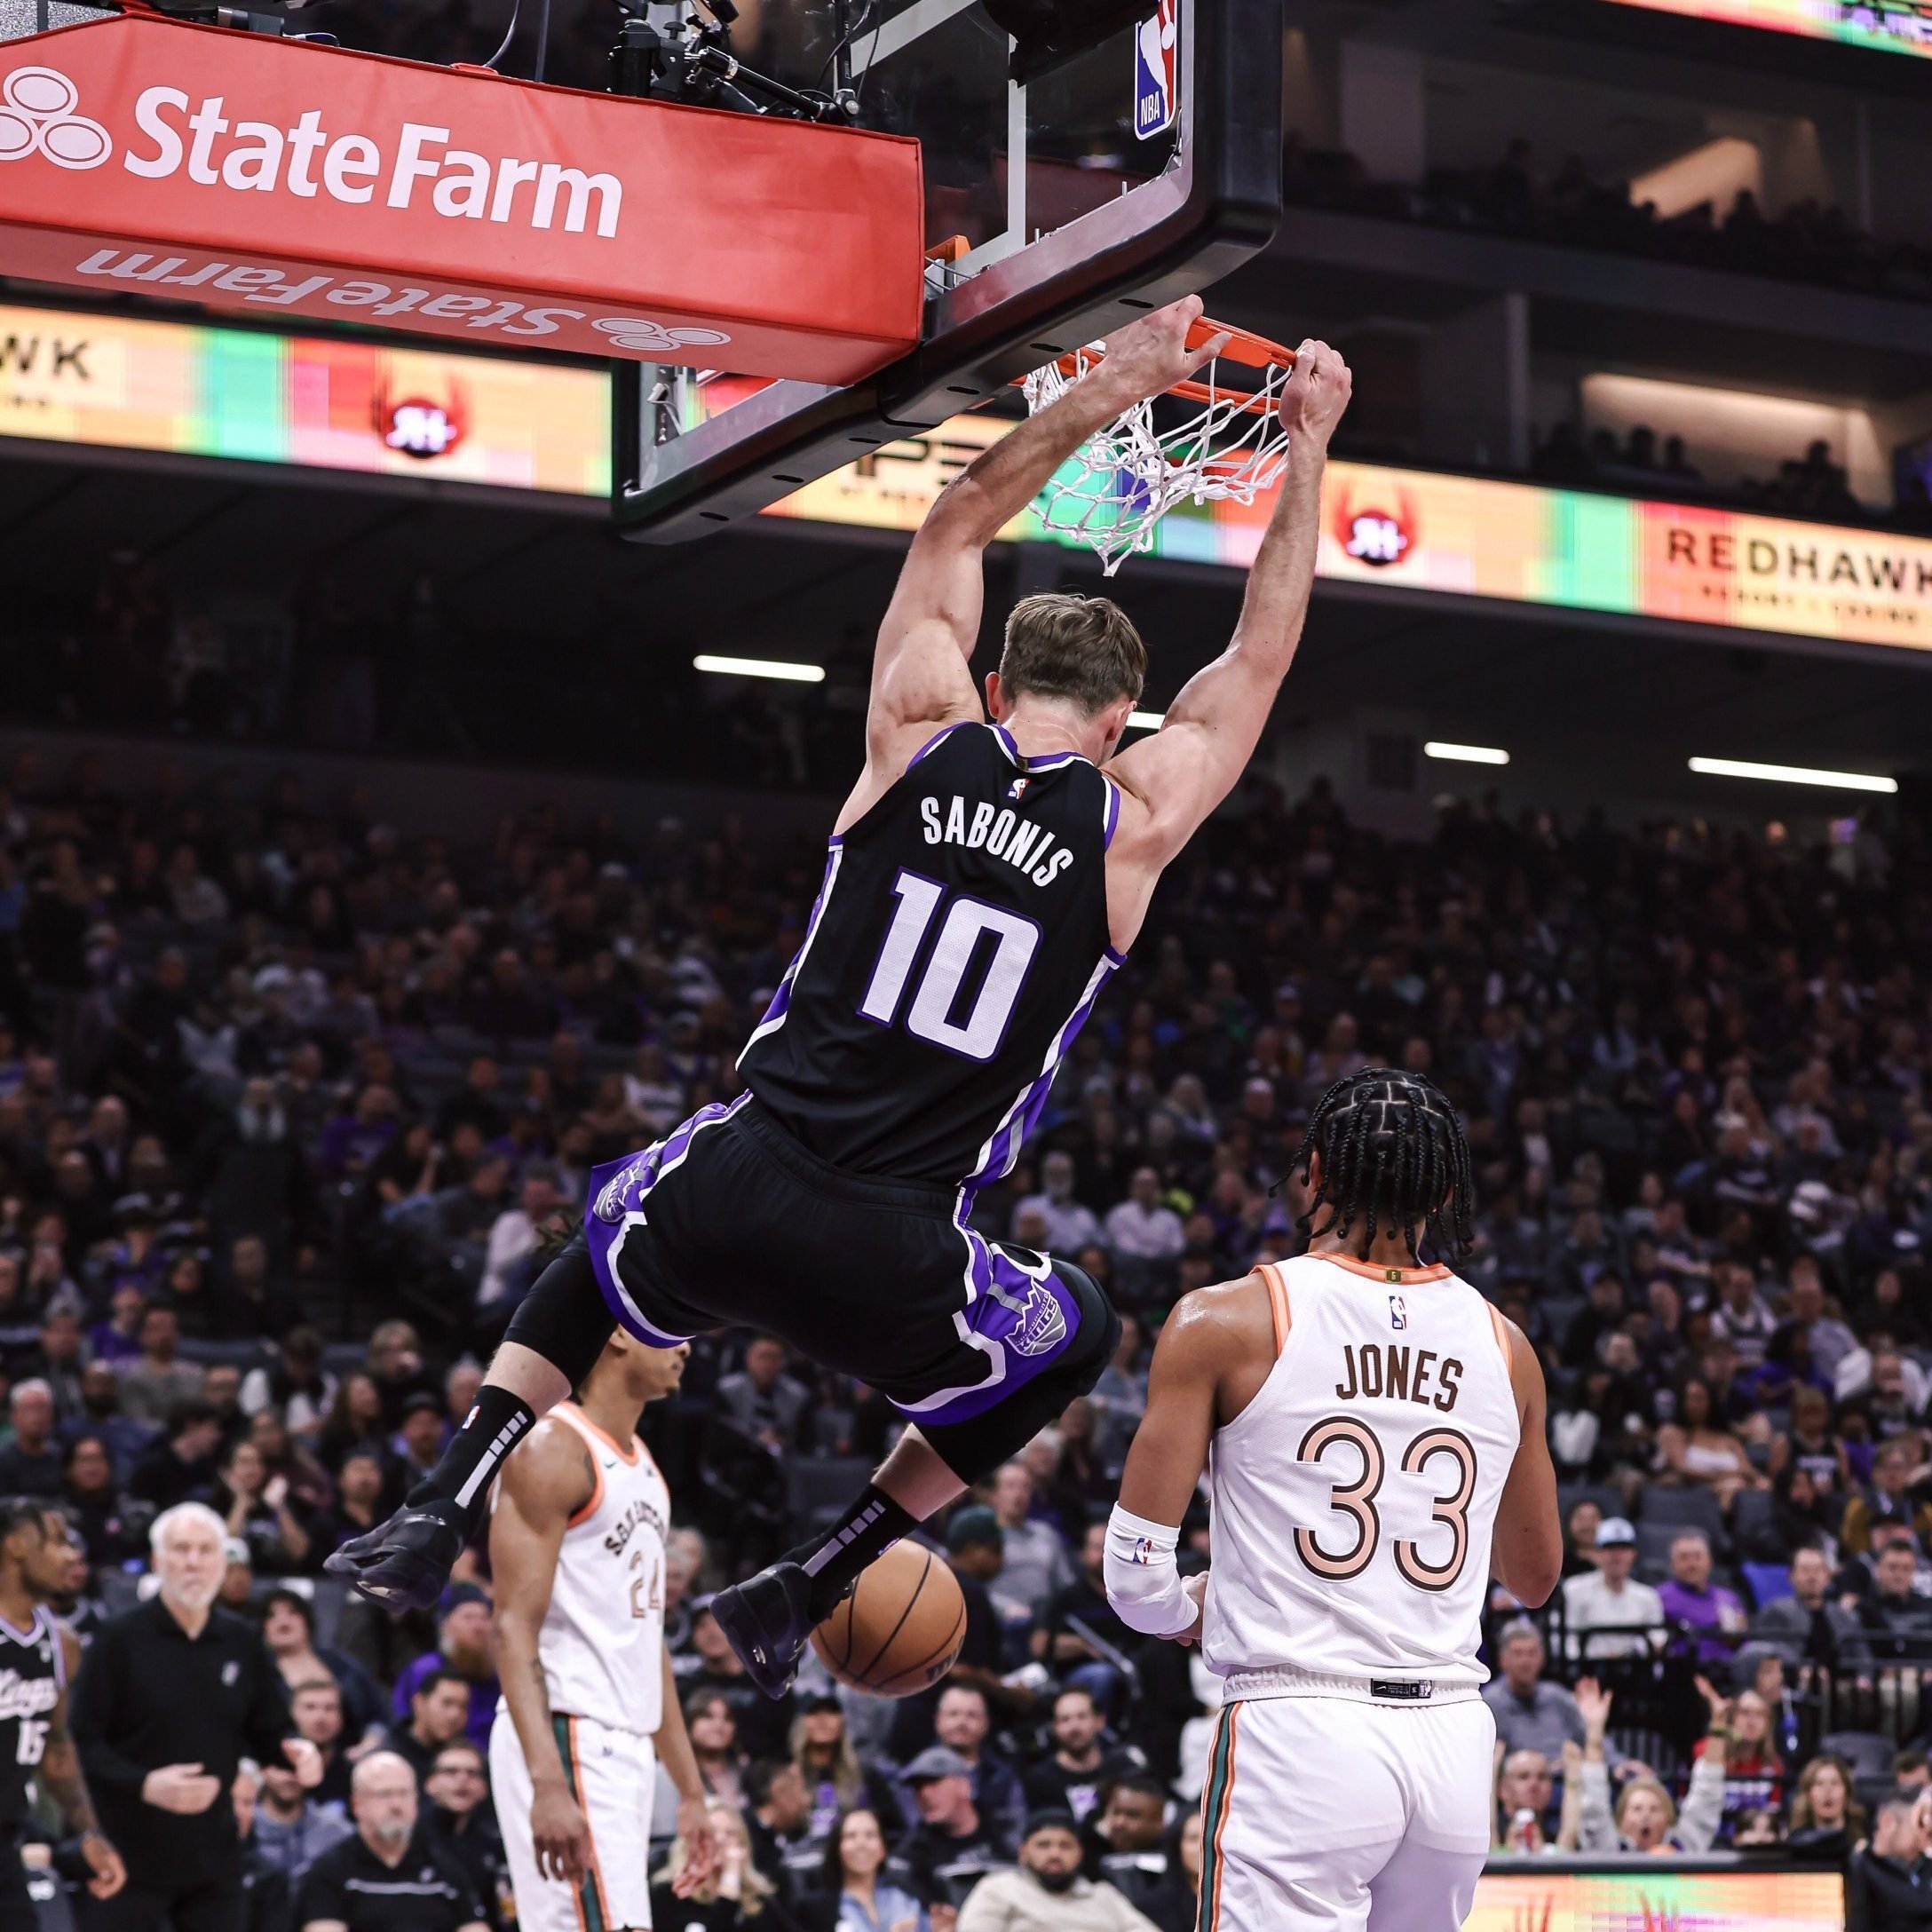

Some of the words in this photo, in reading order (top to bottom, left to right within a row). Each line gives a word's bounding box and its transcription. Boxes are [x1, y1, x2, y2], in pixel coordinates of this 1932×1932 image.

[1140, 91, 1160, 128] NBA
[921, 796, 1073, 887] SABONIS
[857, 866, 1043, 1064] 10
[1016, 1298, 1057, 1351] KINGS
[1335, 1343, 1463, 1413] JONES
[1294, 1415, 1477, 1593] 33
[16, 1719, 51, 1765] 15
